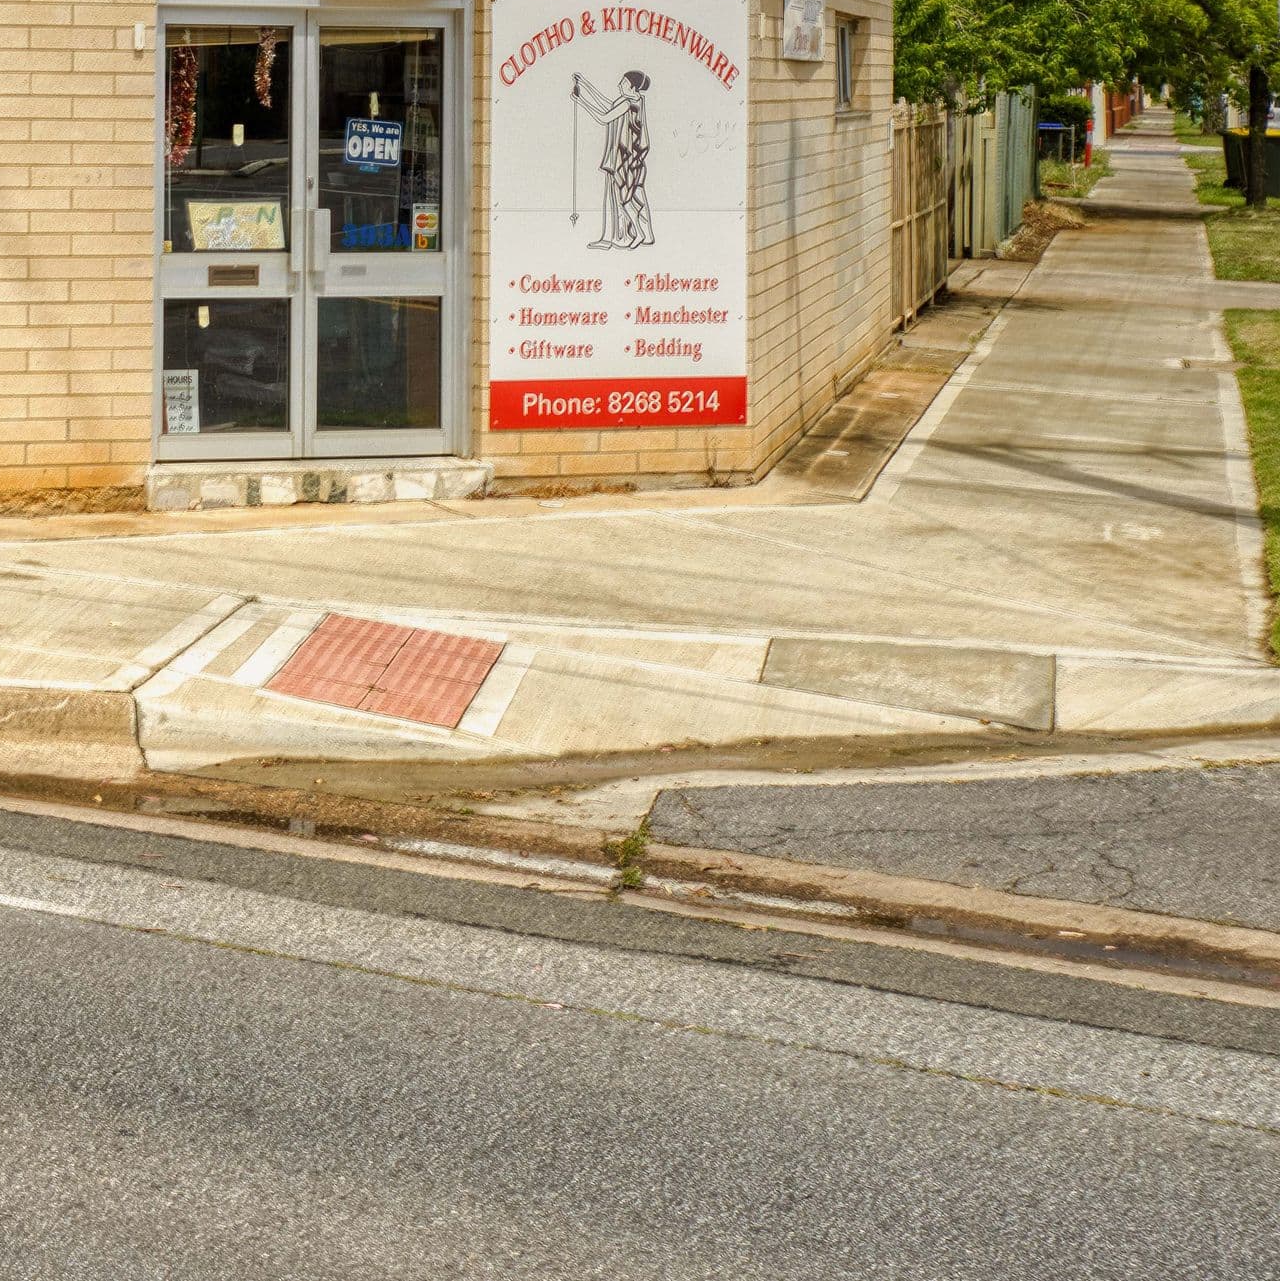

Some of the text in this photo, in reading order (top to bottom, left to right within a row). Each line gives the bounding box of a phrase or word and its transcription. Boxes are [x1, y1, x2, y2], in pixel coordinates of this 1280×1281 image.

[498, 6, 741, 91] CLOTHO & KITCHENWARE
[351, 122, 400, 135] YES, We are
[348, 135, 399, 160] OPEN
[519, 274, 603, 294] Cookware
[634, 273, 719, 293] Tableware
[519, 308, 608, 327] Homeware
[634, 306, 729, 325] Manchester
[519, 339, 594, 359] Giftware
[634, 338, 702, 362] Bedding
[522, 389, 721, 416] Phone: 8268 5214
